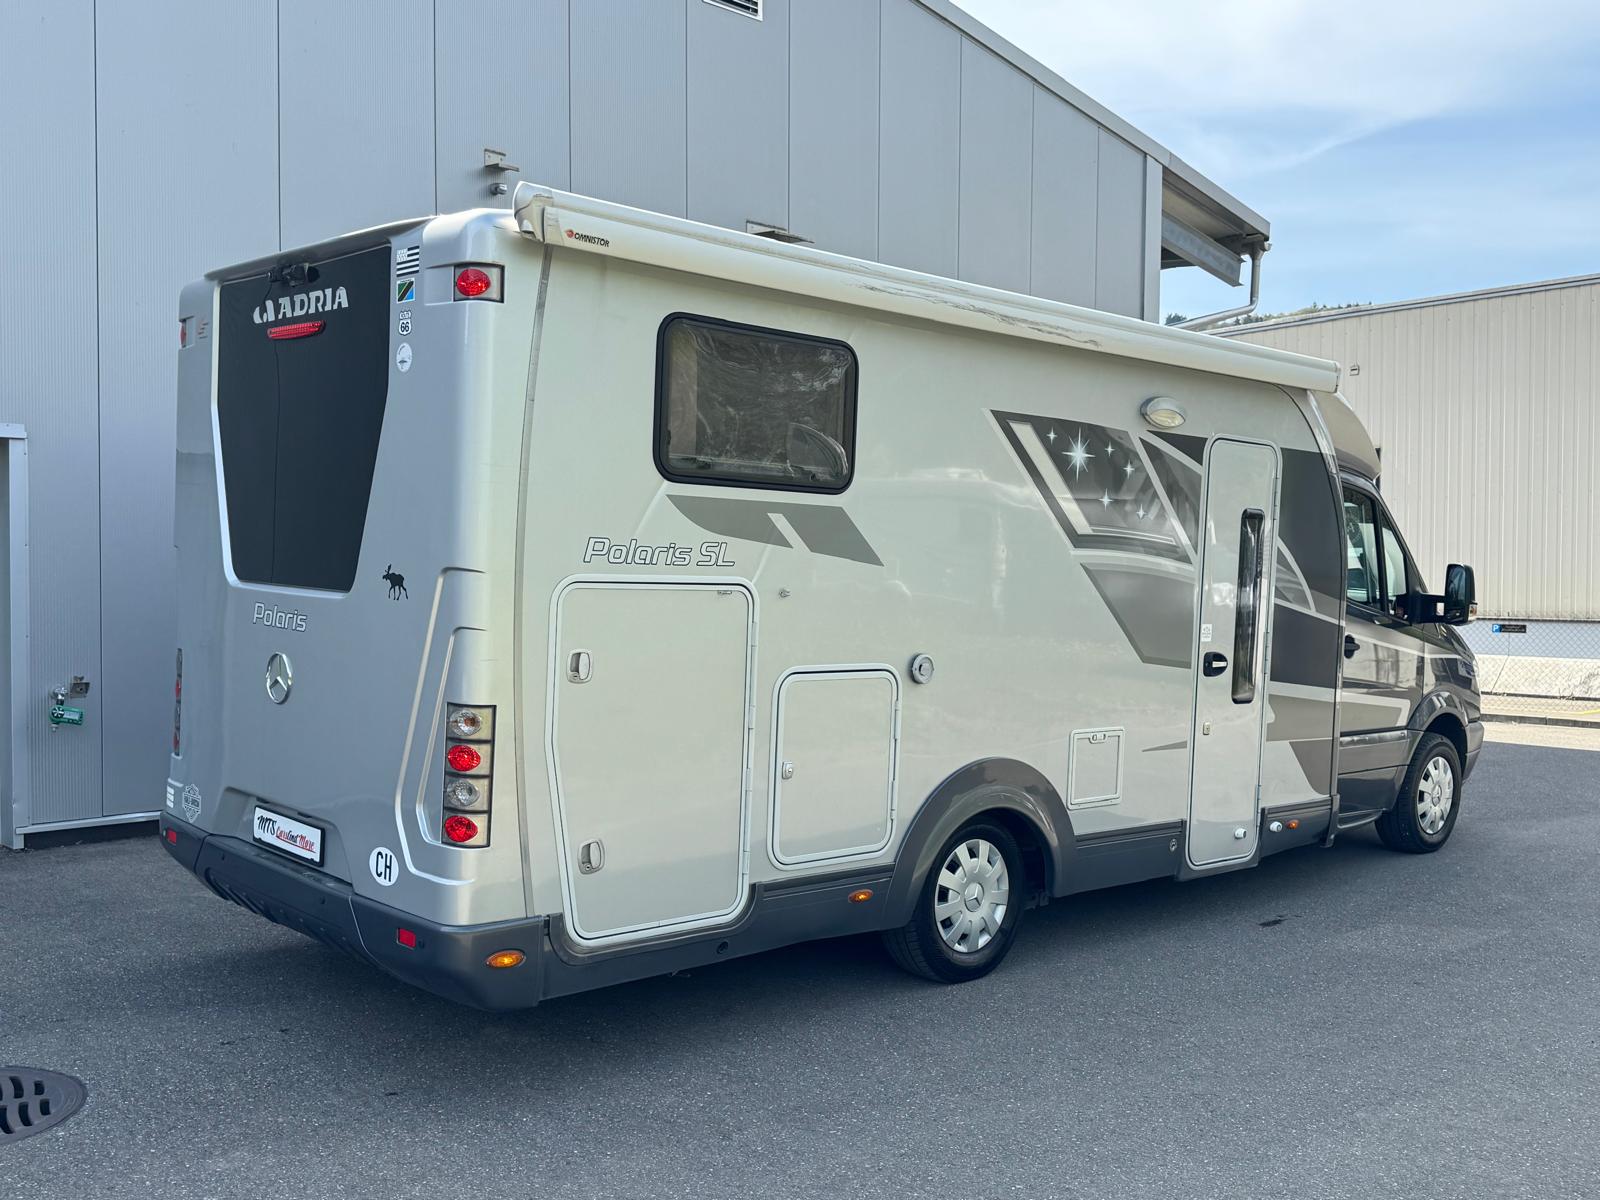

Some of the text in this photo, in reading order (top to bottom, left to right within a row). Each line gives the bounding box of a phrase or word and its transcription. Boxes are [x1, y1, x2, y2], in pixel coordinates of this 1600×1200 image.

[574, 232, 610, 248] OMNISTOR
[278, 286, 349, 320] ADRIA
[400, 321, 410, 333] 66
[583, 537, 735, 567] Polaris SL
[252, 601, 308, 633] Polaris
[257, 815, 277, 836] MTS
[375, 851, 393, 883] CH
